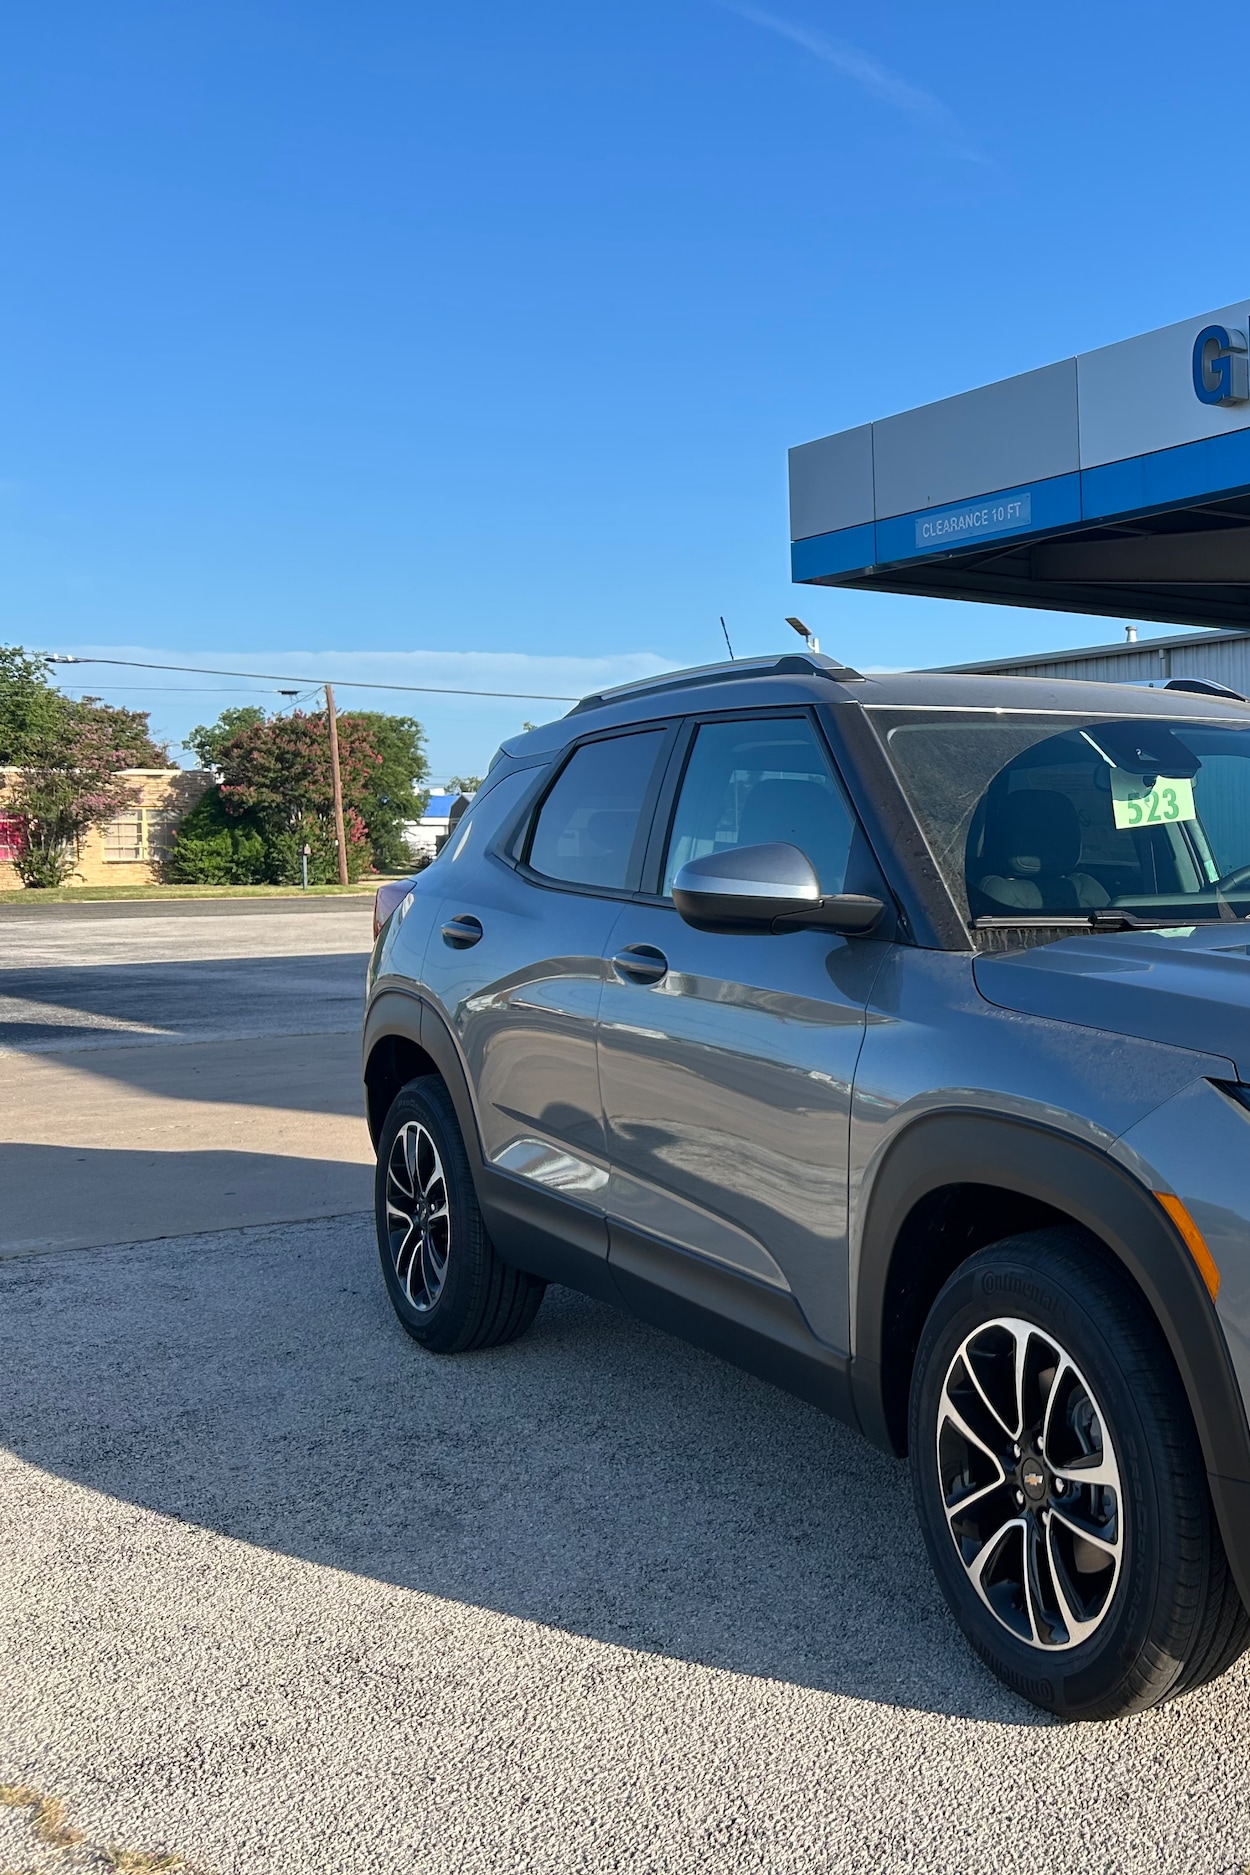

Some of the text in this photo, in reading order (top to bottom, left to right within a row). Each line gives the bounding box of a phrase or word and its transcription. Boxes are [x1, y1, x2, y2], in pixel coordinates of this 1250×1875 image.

[922, 501, 1022, 538] CLEARANCE 10 FT
[1127, 787, 1180, 825] 523
